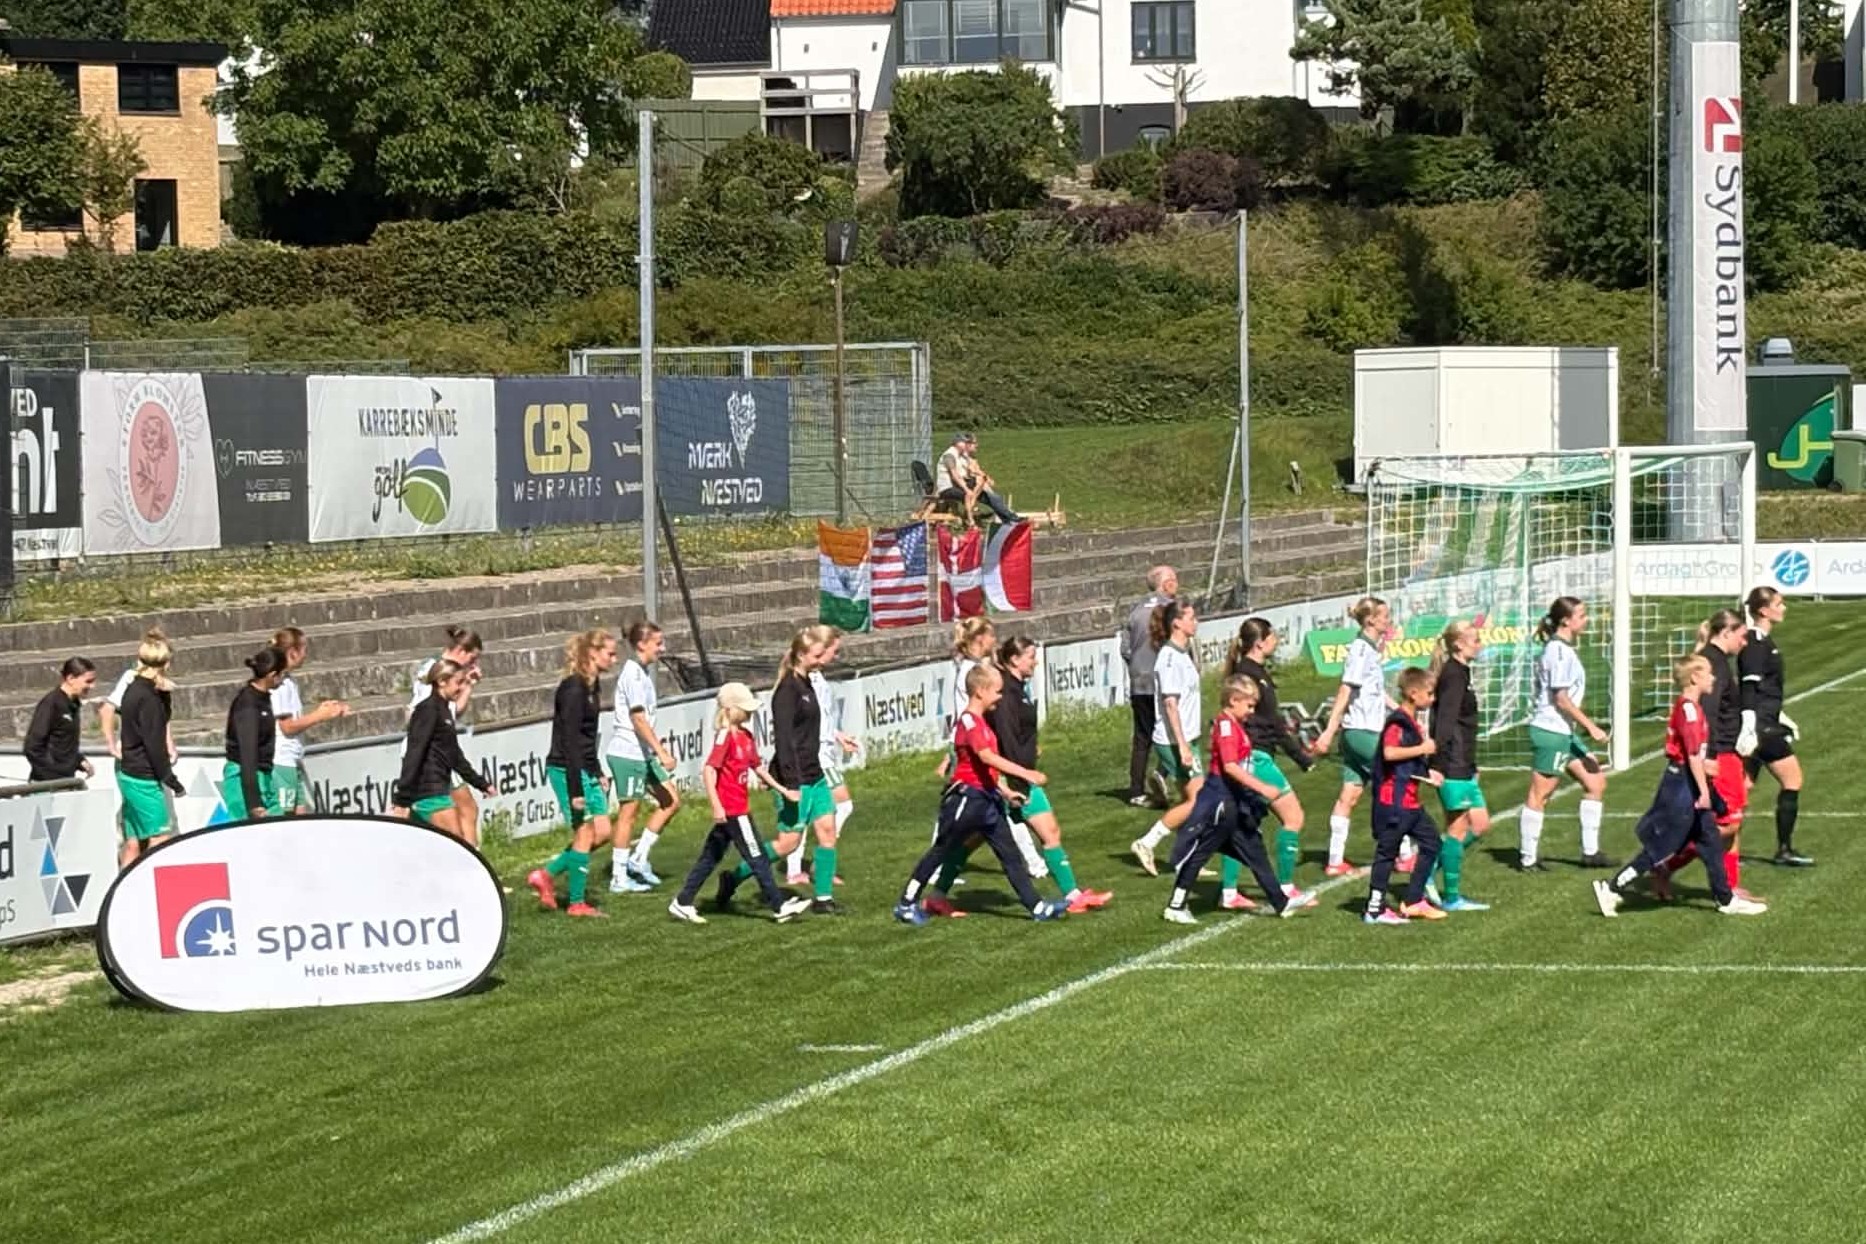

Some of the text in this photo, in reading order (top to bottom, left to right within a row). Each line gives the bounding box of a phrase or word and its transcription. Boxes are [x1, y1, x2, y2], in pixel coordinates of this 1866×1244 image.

[1704, 165, 1743, 376] Sydbank
[358, 407, 458, 437] KARREBÆKSMINDE
[524, 403, 591, 474] CBS
[372, 457, 408, 523] golf
[1048, 655, 1094, 693] Næstved
[865, 682, 926, 730] Næstved
[527, 798, 555, 824] Grus
[257, 908, 460, 961] spar Nord
[304, 957, 463, 977] Hele Næstveds bank
